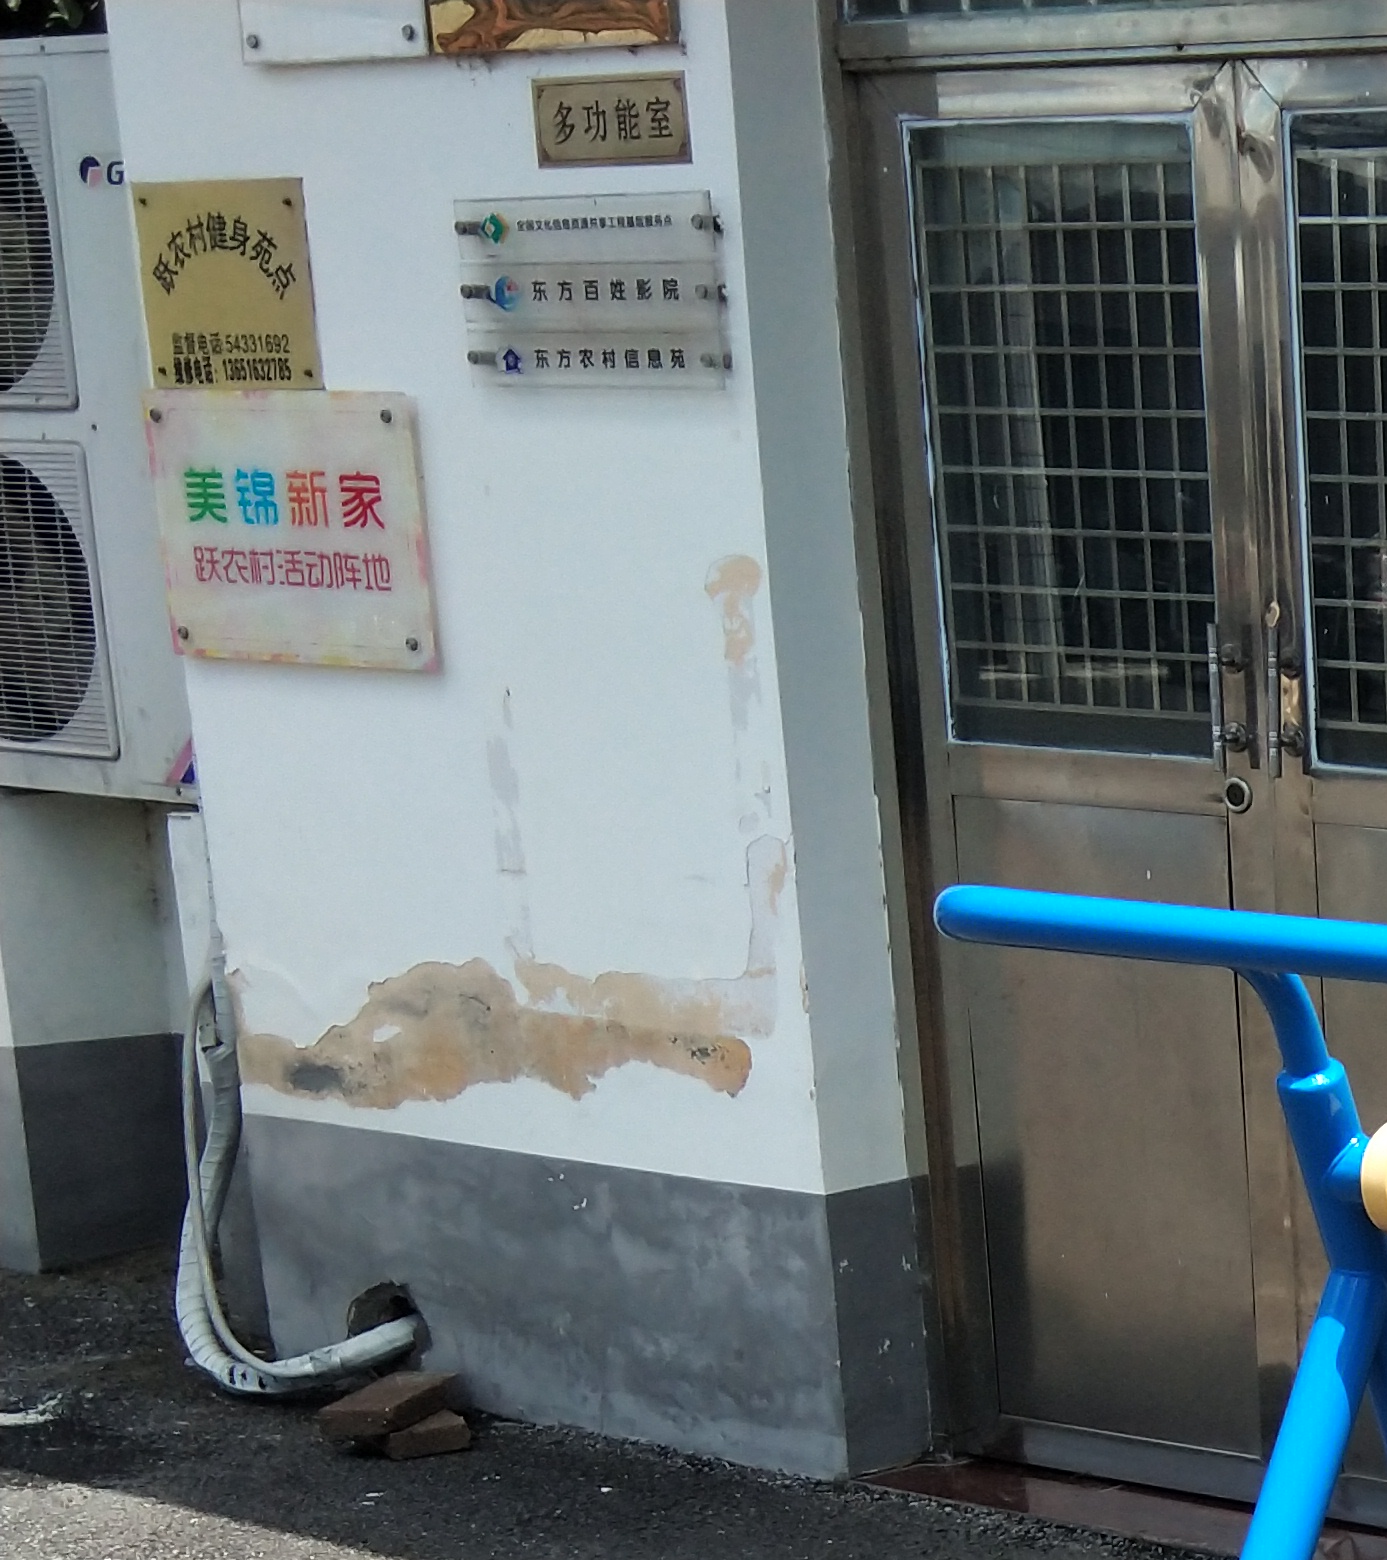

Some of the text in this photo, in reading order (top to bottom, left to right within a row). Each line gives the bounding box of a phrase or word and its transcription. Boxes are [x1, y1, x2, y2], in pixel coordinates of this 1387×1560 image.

[553, 96, 673, 145] 多功能室
[153, 212, 296, 300] 跃农村健身苑点
[531, 278, 680, 301] 东方百姓影院
[534, 349, 686, 369] 东方农村信息苑
[184, 467, 386, 530] 美锦新家
[193, 545, 392, 592] 跃农村活动阵地
